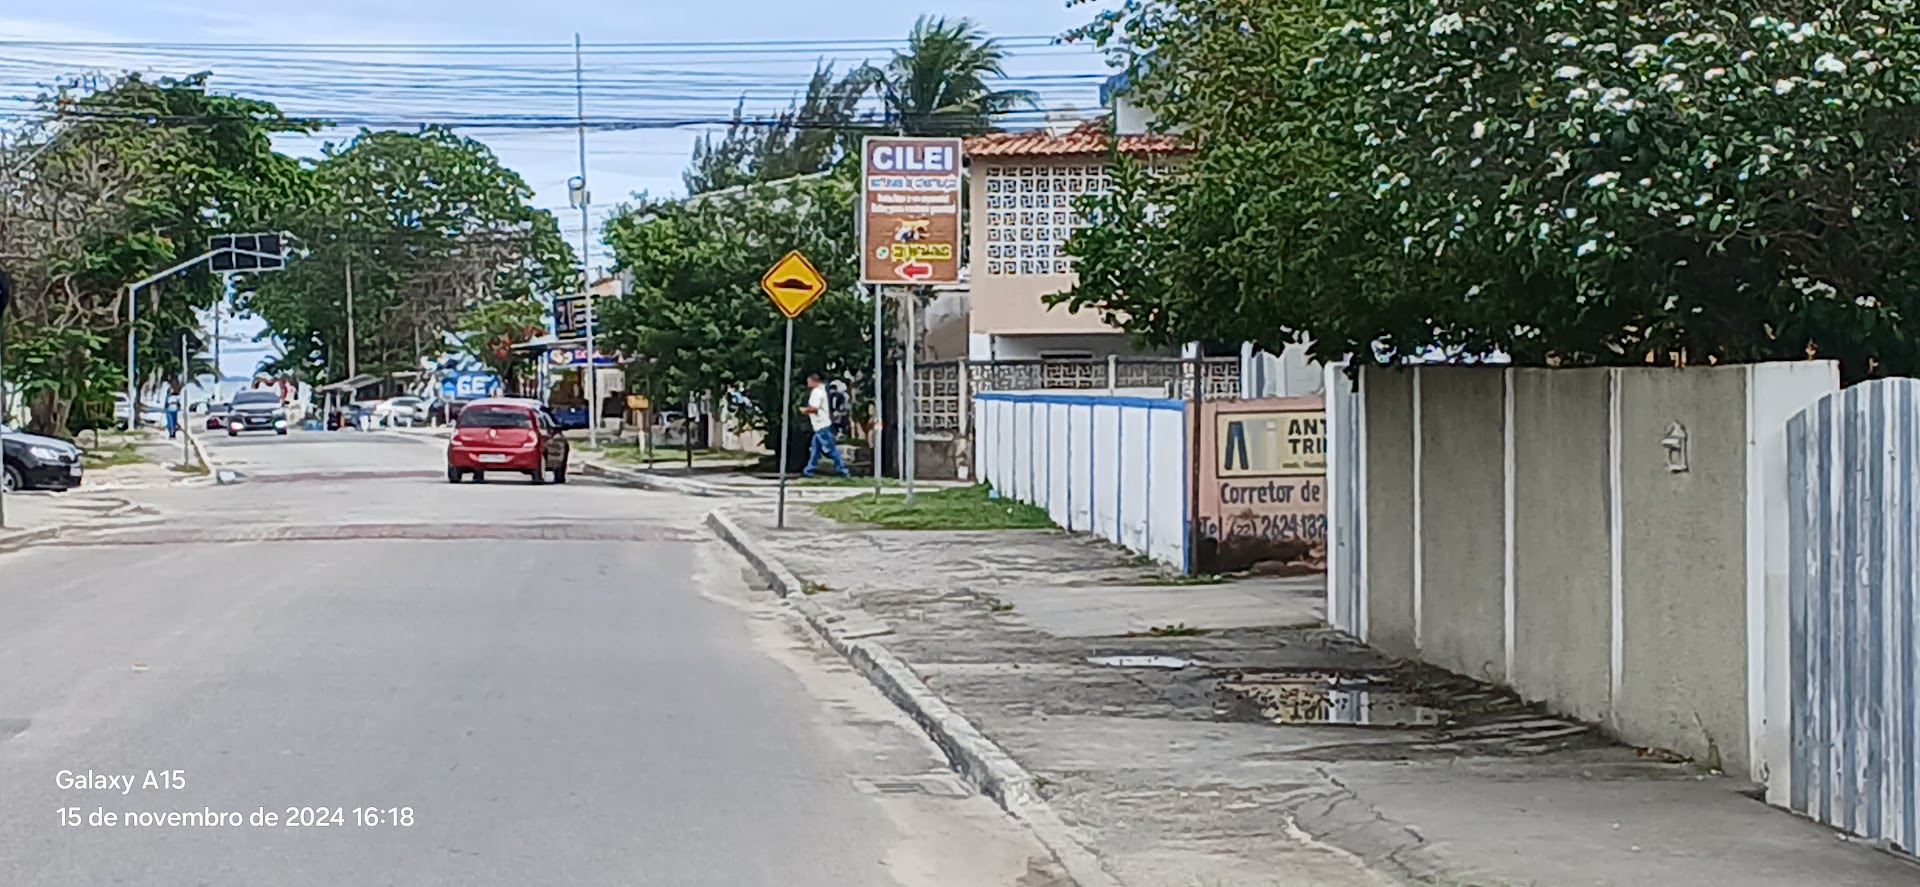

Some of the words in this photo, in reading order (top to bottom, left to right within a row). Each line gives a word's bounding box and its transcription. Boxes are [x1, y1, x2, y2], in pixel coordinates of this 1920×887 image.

[872, 146, 954, 171] CILEI
[1220, 480, 1295, 504] Corretor
[1300, 479, 1321, 503] de
